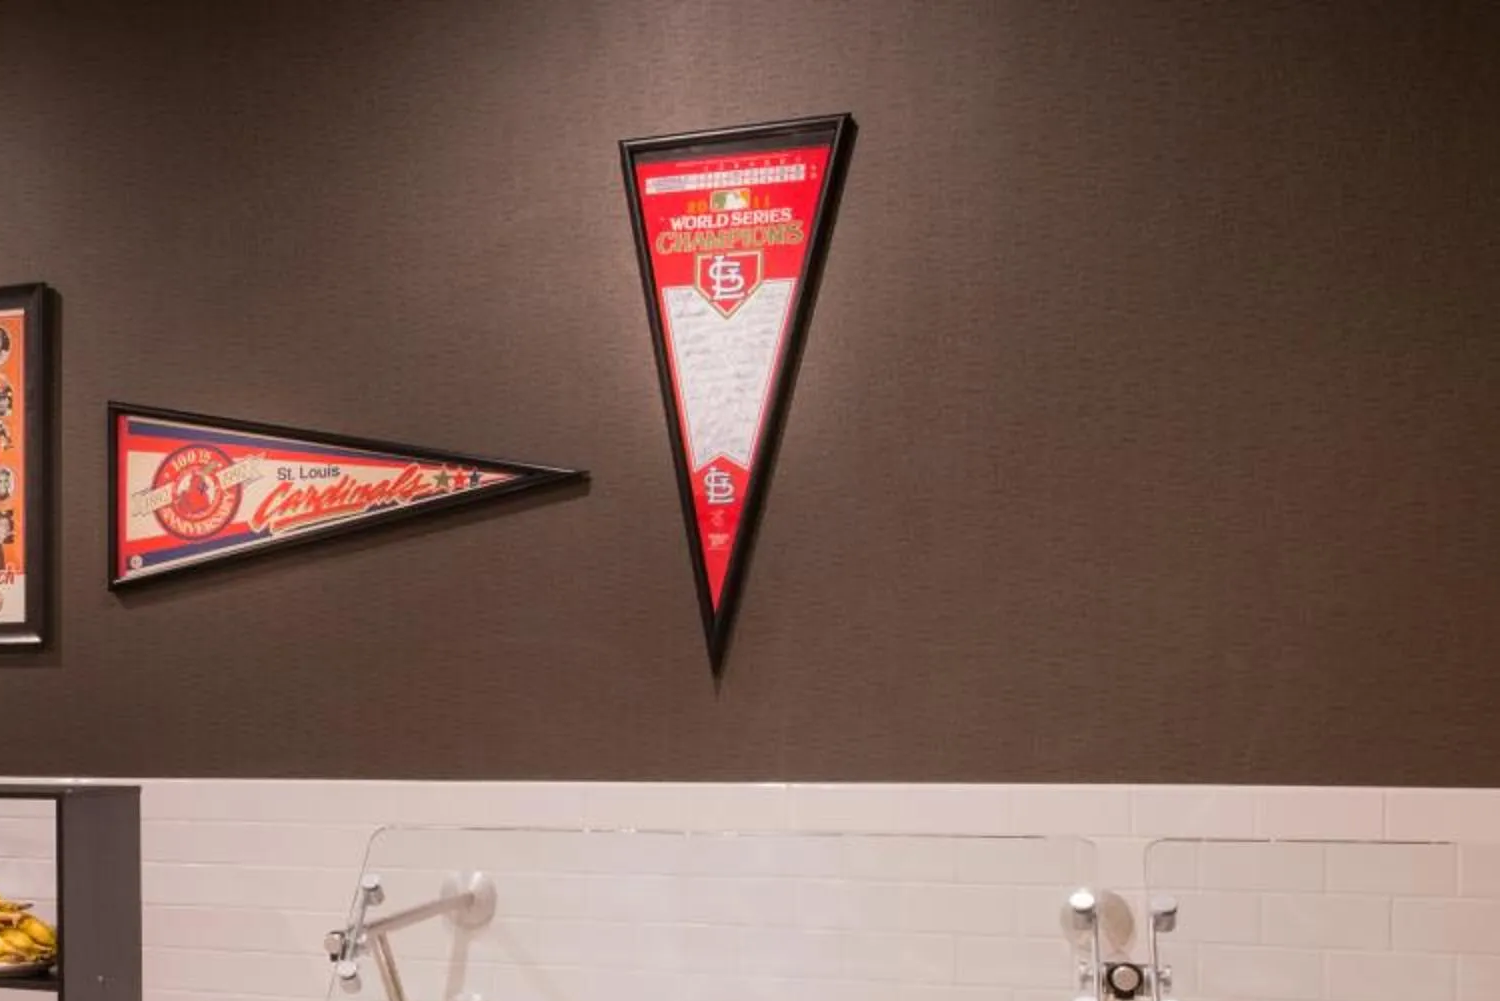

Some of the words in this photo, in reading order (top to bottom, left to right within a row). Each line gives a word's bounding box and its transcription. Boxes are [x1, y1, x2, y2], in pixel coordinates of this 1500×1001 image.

[670, 212, 729, 230] WORLD
[730, 207, 793, 225] SERIES
[656, 220, 804, 255] CHAMPIONS
[276, 467, 295, 481] St.
[299, 464, 341, 480] Louis
[251, 463, 433, 534] Cardinals
